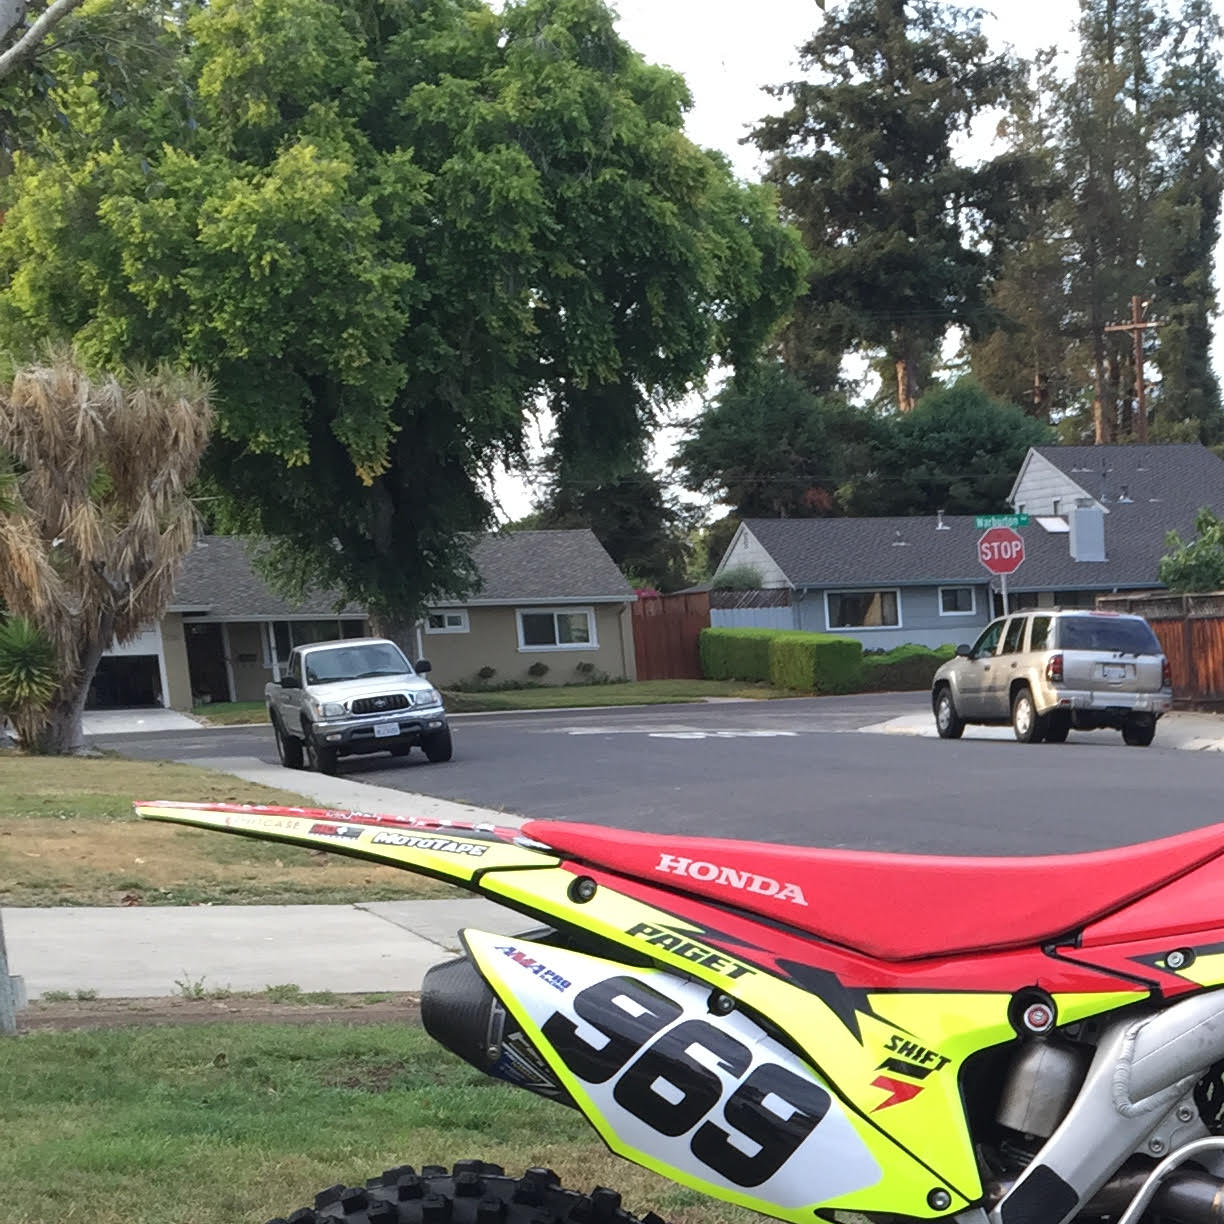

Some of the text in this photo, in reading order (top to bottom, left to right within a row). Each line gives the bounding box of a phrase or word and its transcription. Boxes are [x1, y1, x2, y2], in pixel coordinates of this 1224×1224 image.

[981, 541, 1021, 560] STOP
[655, 853, 809, 907] HONDA
[494, 946, 546, 975] AMA
[624, 922, 758, 979] PAGET
[883, 1034, 952, 1071] SHIFT
[540, 975, 832, 1188] 969
